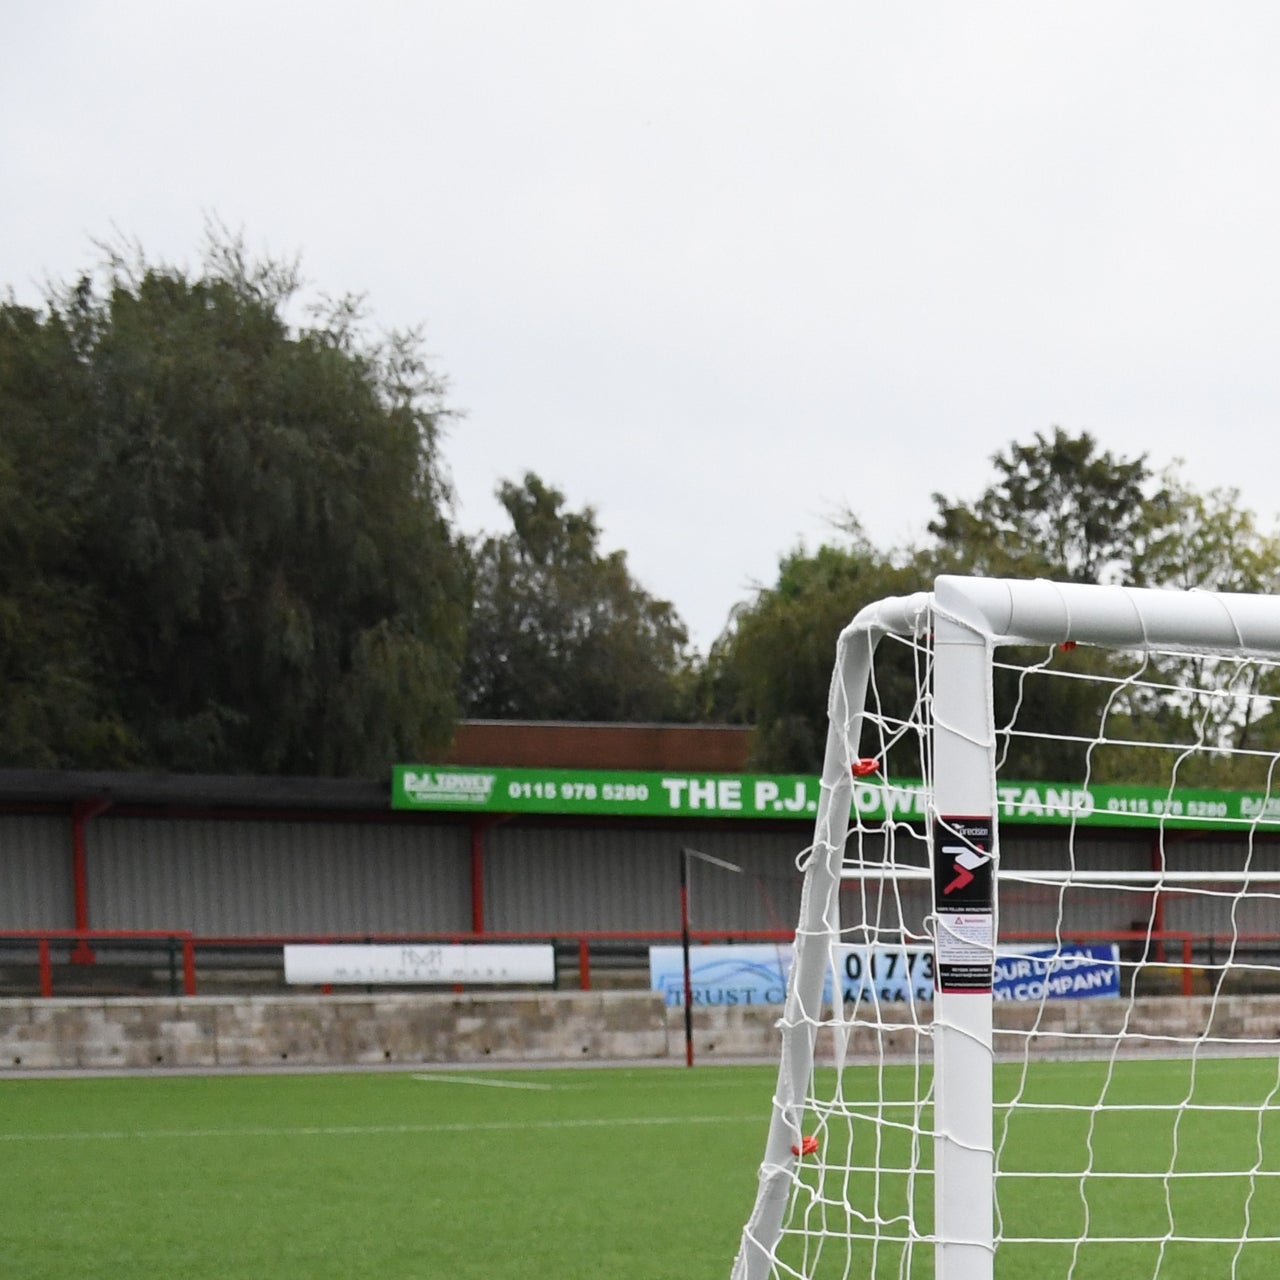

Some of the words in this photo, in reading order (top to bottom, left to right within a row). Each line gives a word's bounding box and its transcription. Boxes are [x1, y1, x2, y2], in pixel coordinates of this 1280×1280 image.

[508, 781, 556, 799] 0115
[561, 783, 597, 800] 978
[661, 778, 742, 809] THE
[755, 781, 817, 811] P.J.
[998, 787, 1096, 818] TAND
[1107, 797, 1148, 812] 0115
[845, 953, 934, 981] 01773
[994, 960, 1032, 984] OUR
[1033, 949, 1096, 976] LOCAL
[1014, 967, 1114, 1002] COMPANY
